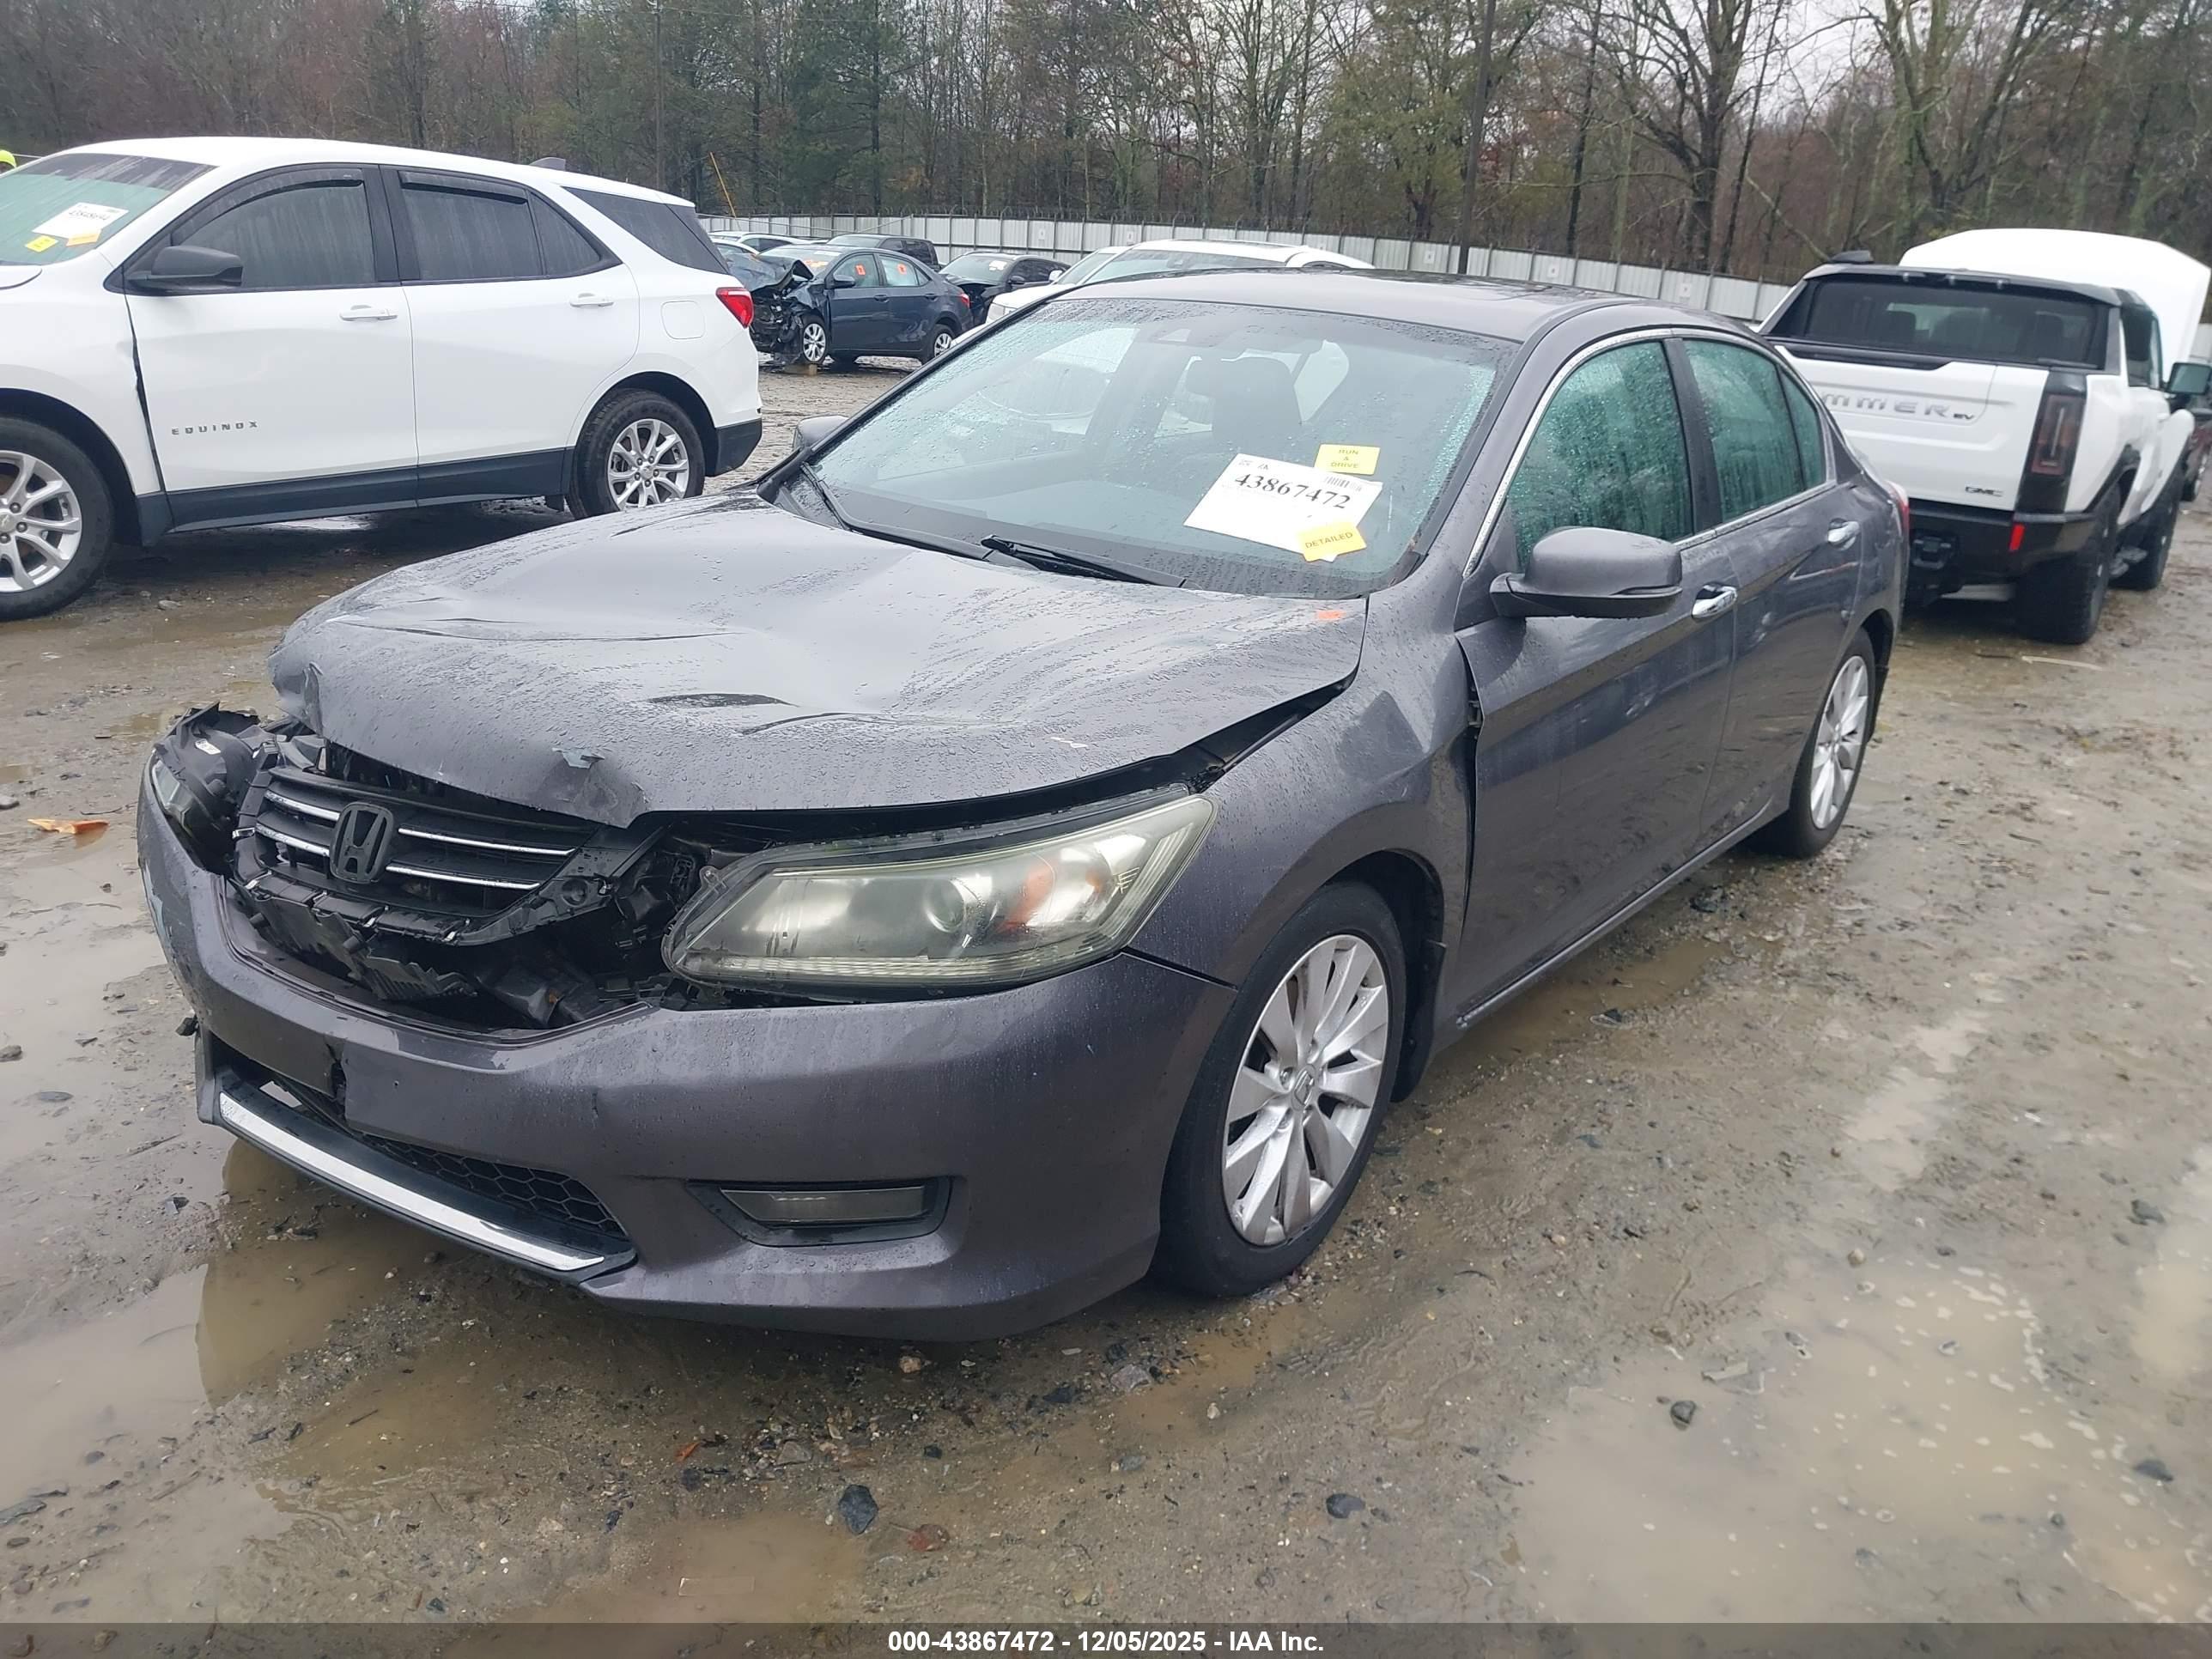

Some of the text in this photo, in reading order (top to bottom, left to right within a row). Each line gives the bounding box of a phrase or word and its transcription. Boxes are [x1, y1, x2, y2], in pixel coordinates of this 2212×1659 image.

[172, 421, 258, 435] EQUINOX
[1234, 472, 1351, 509] 43867472
[1965, 486, 2004, 497] GMC
[1304, 532, 1353, 549] DETAILED
